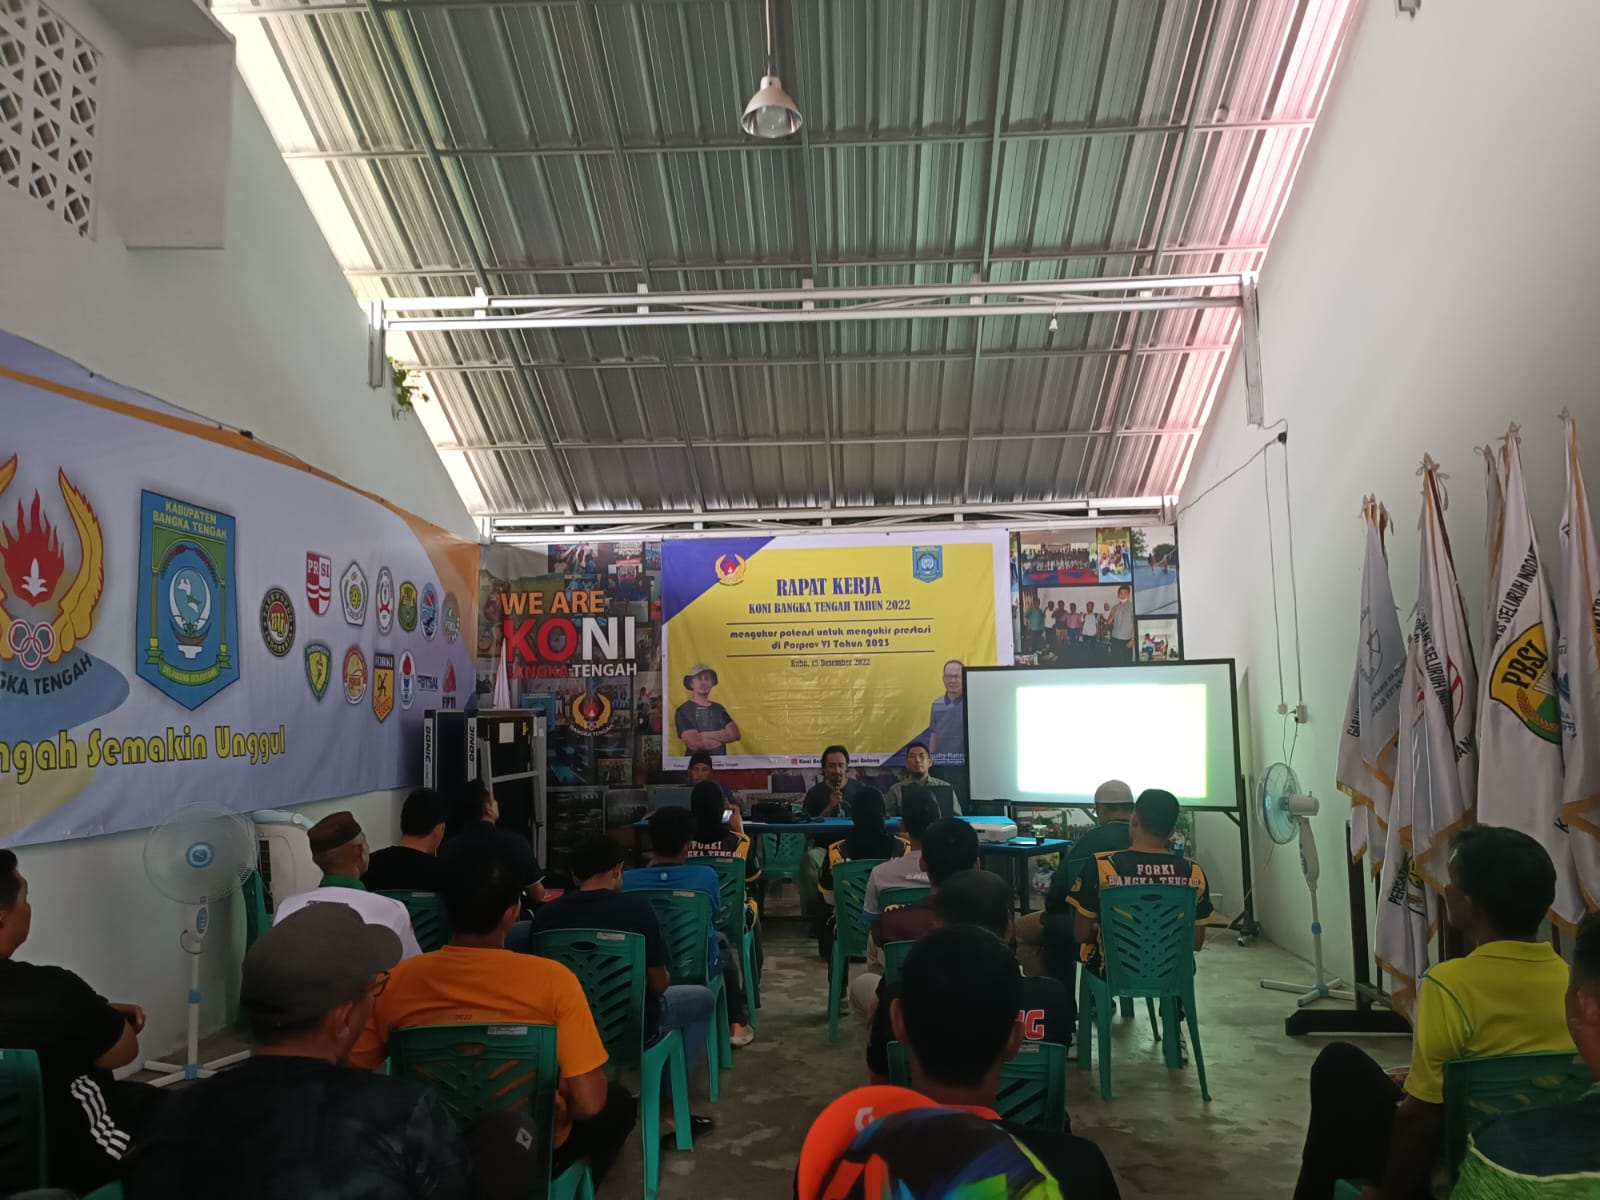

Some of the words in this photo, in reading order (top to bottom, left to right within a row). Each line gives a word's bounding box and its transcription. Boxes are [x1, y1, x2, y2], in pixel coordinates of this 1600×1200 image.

[152, 511, 190, 530] BANGKA
[192, 521, 227, 539] TENGAH
[165, 501, 216, 524] KABUPATEN
[776, 578, 827, 597] RAPAT
[833, 576, 882, 596] KERJA
[501, 592, 544, 615] WE
[551, 590, 605, 614] ARE
[749, 603, 771, 614] KONI
[774, 602, 811, 613] BANGKA
[815, 601, 850, 612] TENGAH
[854, 600, 883, 611] TAHUN
[886, 599, 911, 610] 2022
[1498, 580, 1529, 623] SELURUH
[503, 616, 636, 662] KONI
[730, 629, 777, 640] mengukur
[780, 628, 814, 639] potensi
[817, 627, 844, 636] untuk
[846, 626, 891, 637] mengukir
[894, 625, 931, 635] prestasi
[771, 641, 781, 649] di
[784, 641, 819, 650] Porprov
[834, 639, 863, 648] Tahun
[33, 653, 93, 695] TENGAH
[571, 663, 637, 678] TENGAH
[1424, 646, 1447, 692] SELURUH
[1501, 639, 1548, 690] PBSI
[87, 725, 208, 768] Semakin
[215, 724, 286, 765] Unggul
[1136, 864, 1175, 875] FORKI
